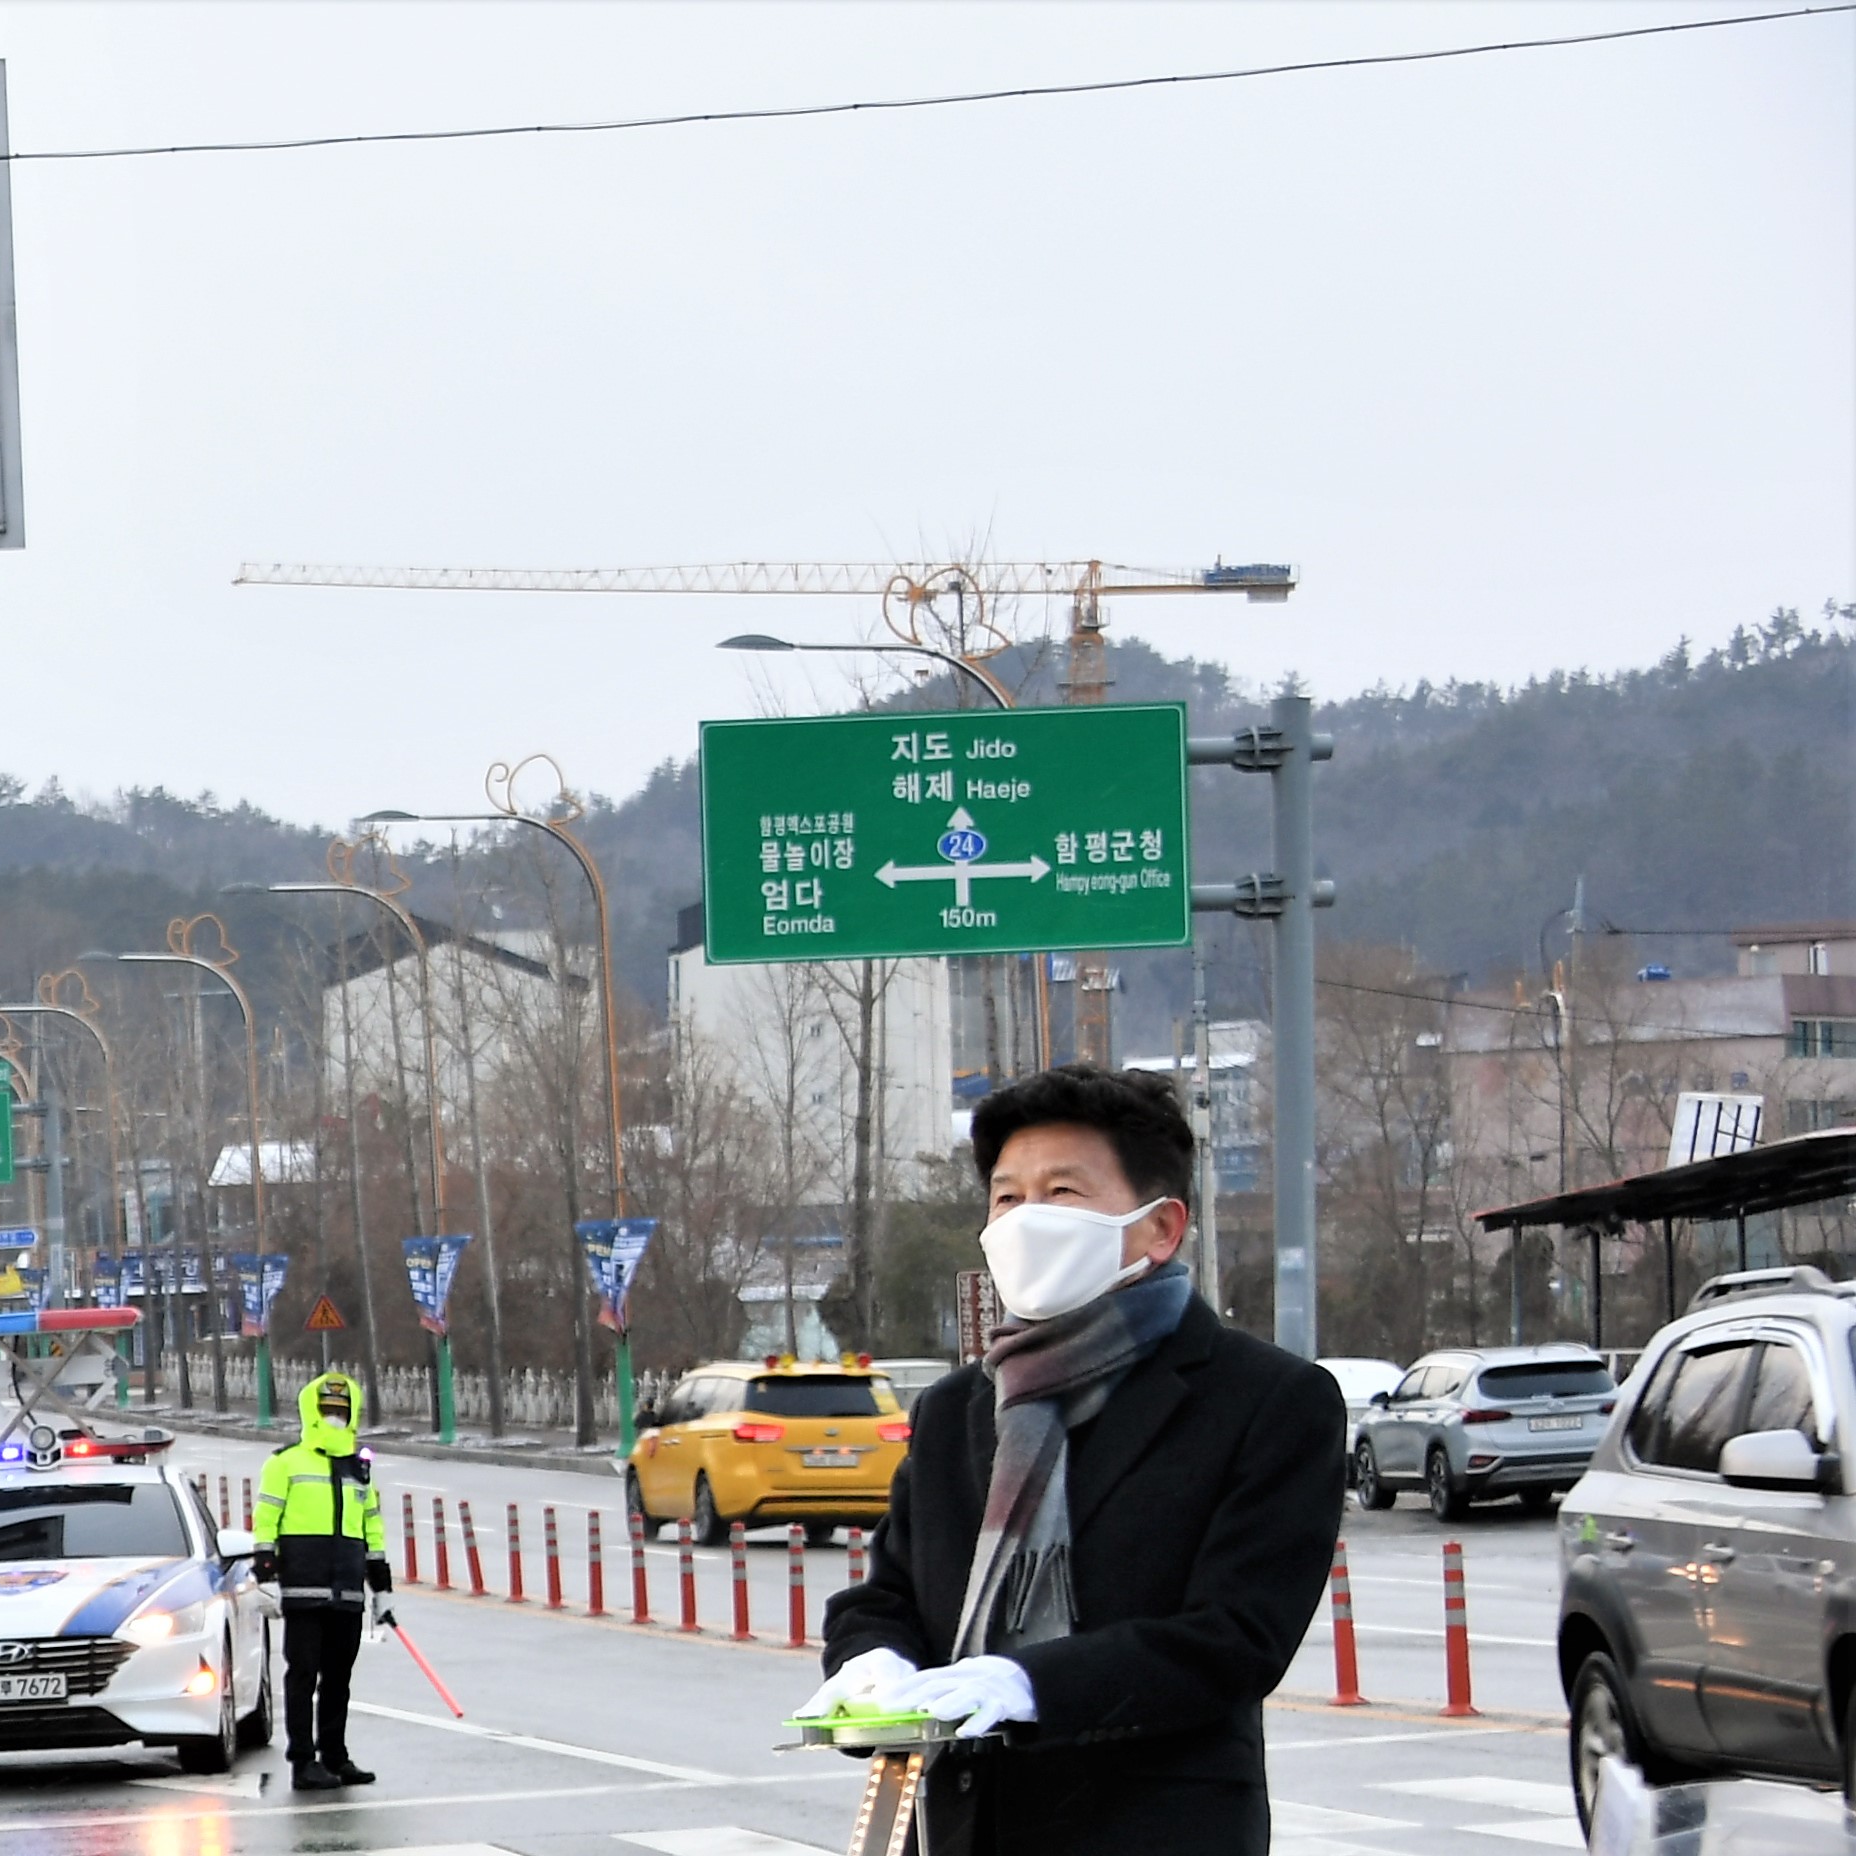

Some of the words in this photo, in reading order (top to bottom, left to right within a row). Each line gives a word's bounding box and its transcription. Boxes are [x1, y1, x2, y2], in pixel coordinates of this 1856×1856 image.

[891, 732, 953, 763] 지도
[966, 739, 1017, 759] Jido
[892, 770, 953, 803] 해제
[966, 778, 1031, 802] Haeje
[759, 838, 854, 873] 물놀이장
[949, 835, 974, 857] 24
[1054, 829, 1163, 864] 함평군청
[1140, 868, 1171, 888] Office
[760, 877, 823, 911] 엄다
[763, 913, 836, 936] Eomda
[939, 908, 997, 928] 150m
